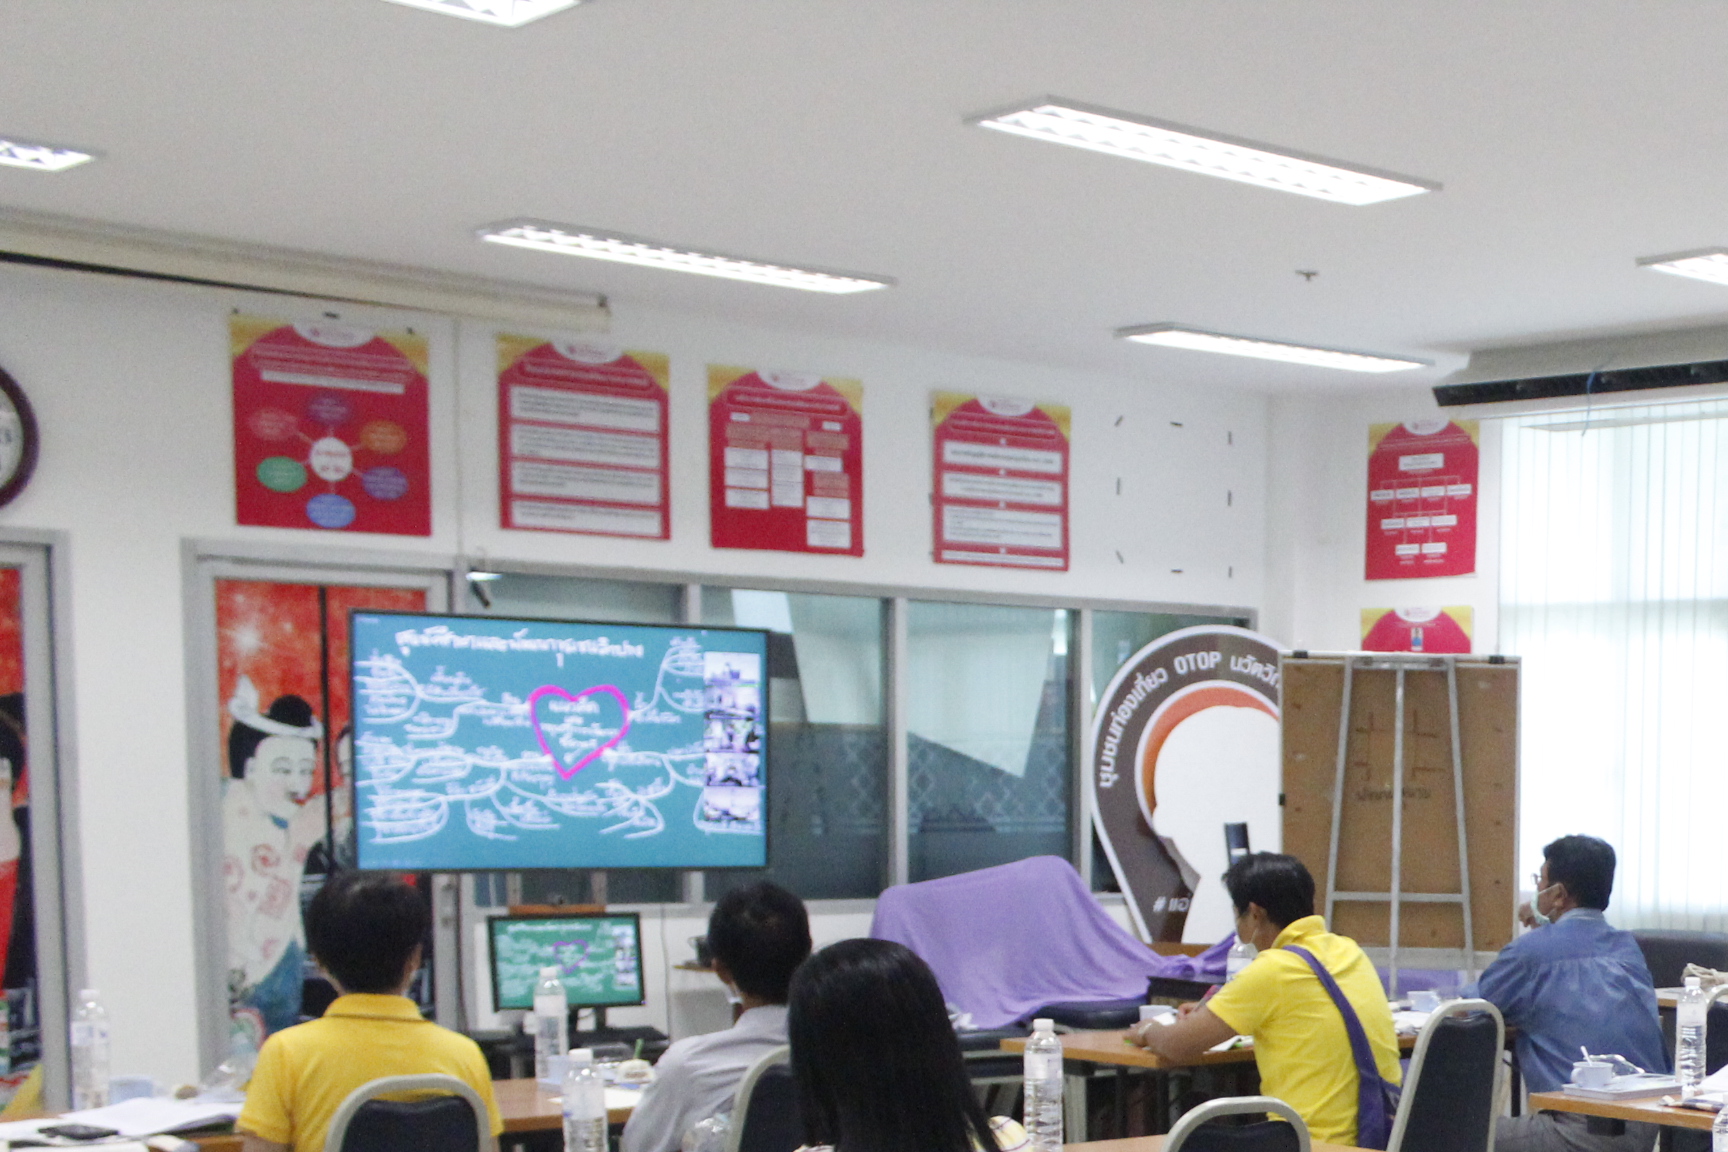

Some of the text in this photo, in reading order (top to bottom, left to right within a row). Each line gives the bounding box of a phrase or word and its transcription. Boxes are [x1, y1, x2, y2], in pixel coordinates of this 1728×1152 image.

[1099, 667, 1169, 788] ชุมชนท่องเที่ยว
[1173, 651, 1222, 675] OTOP
